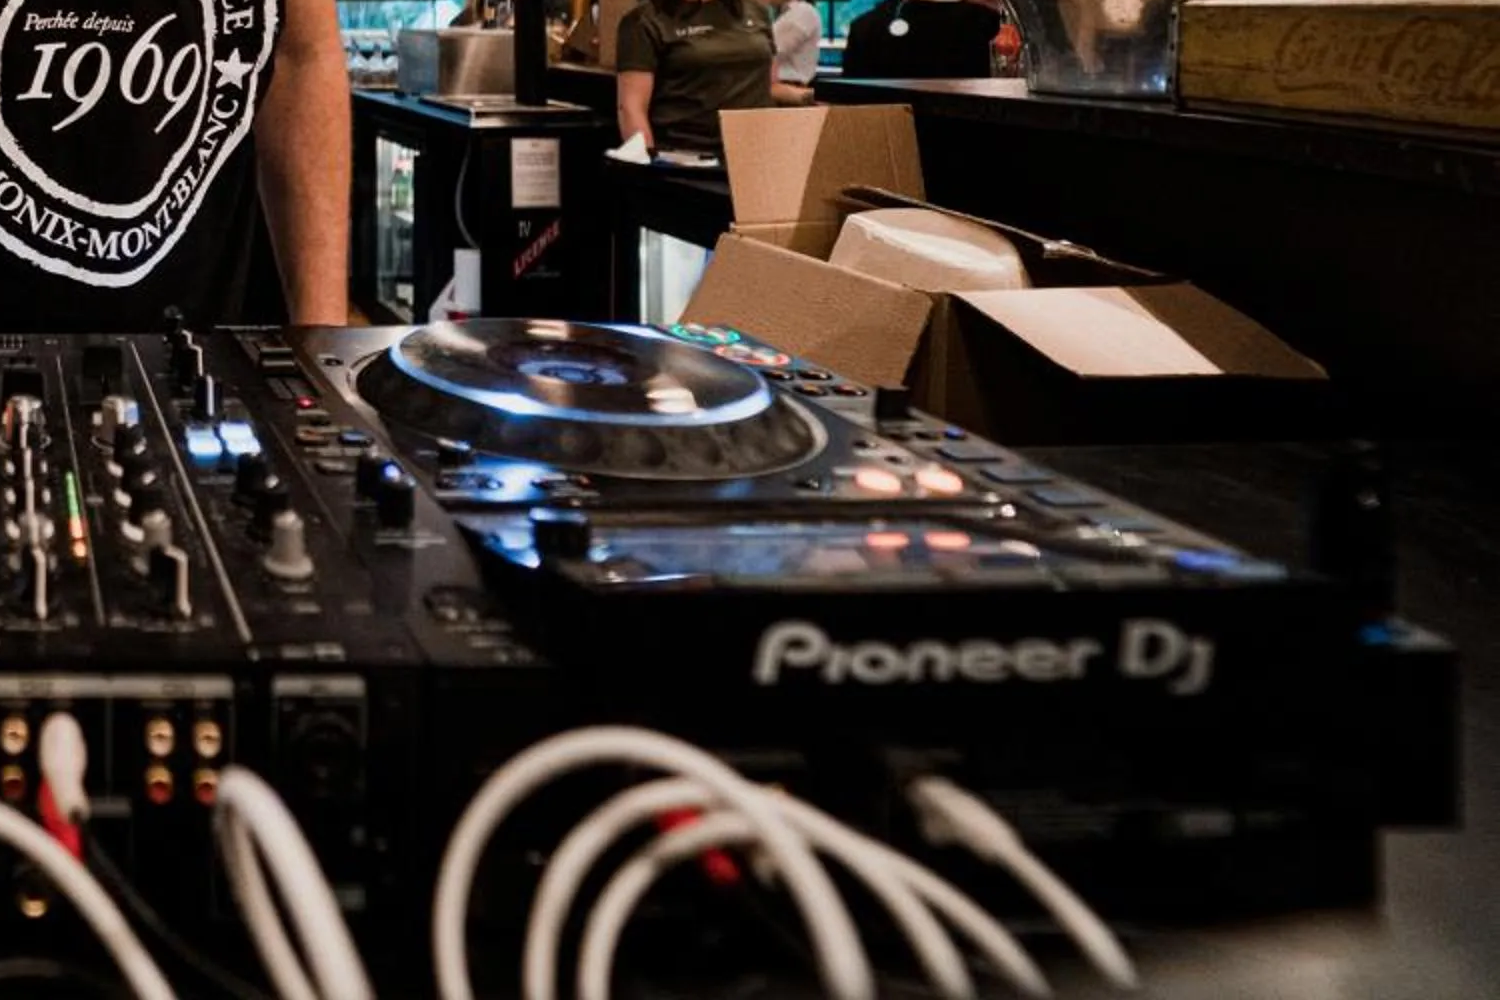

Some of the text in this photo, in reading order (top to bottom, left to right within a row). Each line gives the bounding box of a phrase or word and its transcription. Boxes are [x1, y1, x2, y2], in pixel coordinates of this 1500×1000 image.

[23, 10, 135, 37] Perchée depuis
[16, 13, 202, 134] 1969
[752, 618, 1102, 685] Pioneer
